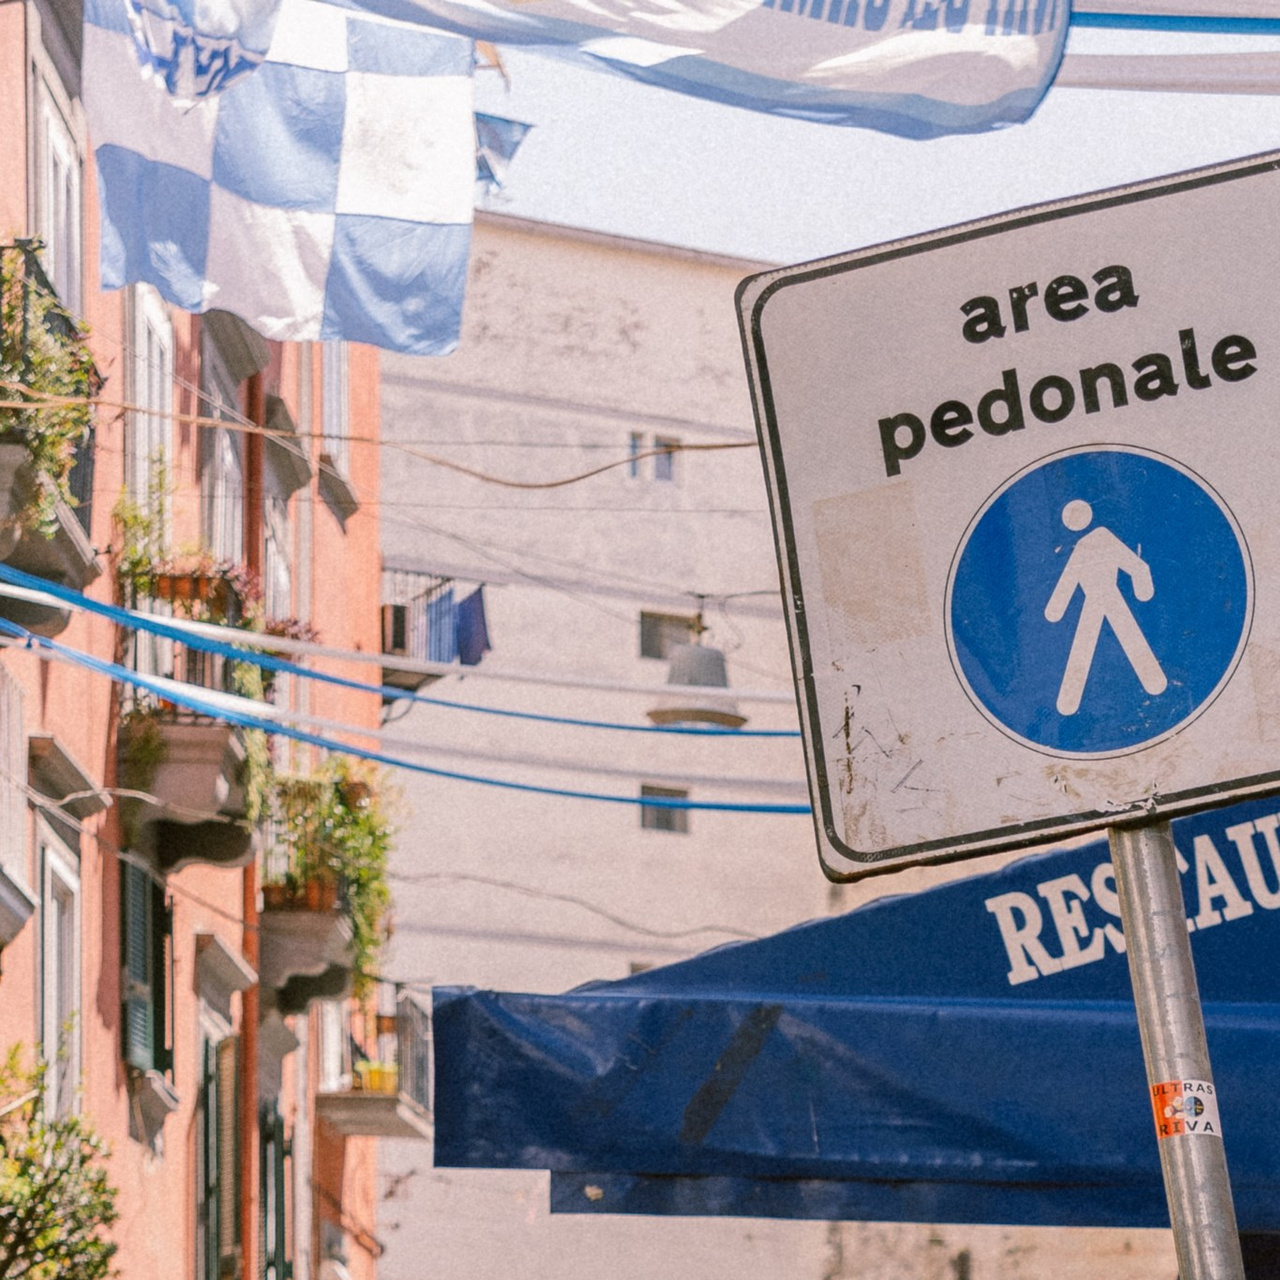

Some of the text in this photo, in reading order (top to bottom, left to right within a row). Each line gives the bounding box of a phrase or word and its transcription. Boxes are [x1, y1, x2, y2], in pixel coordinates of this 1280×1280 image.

[959, 265, 1140, 345] area
[876, 327, 1258, 478] pedonale
[1152, 1082, 1214, 1097] ULTRAS
[1159, 1120, 1214, 1137] RIVA
